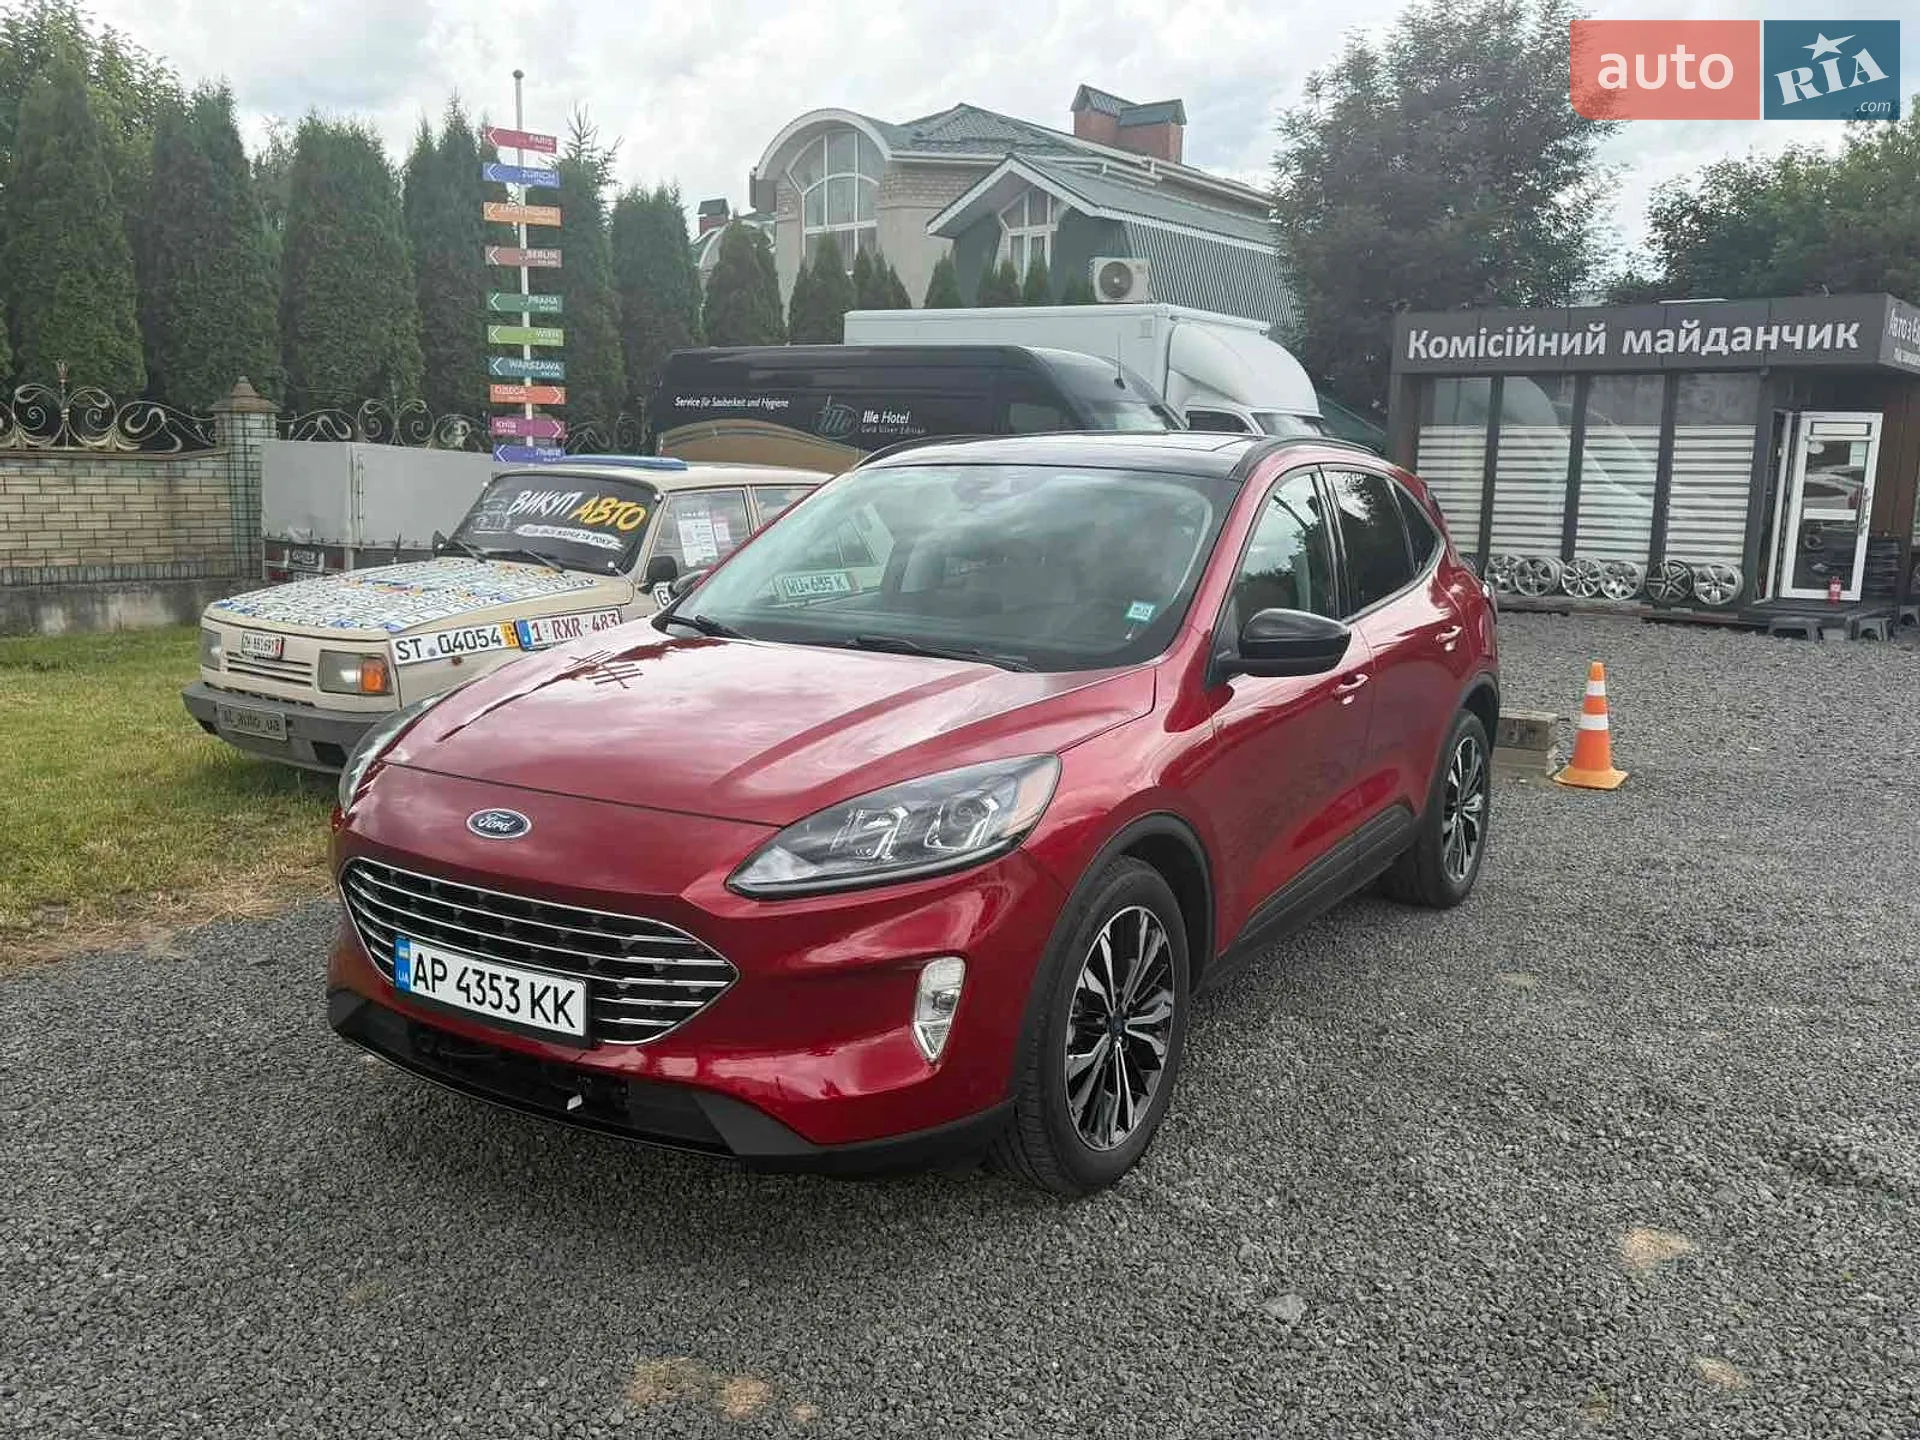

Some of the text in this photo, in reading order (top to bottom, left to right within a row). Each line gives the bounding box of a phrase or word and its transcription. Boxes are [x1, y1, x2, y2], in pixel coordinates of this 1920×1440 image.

[1408, 319, 1860, 359] Комісійний майданчик
[509, 360, 560, 370] WARSZAWA
[674, 396, 700, 407] Service
[881, 410, 910, 424] Hotel
[506, 489, 647, 532] ВИКУП АВТО
[395, 636, 422, 661] ST
[398, 971, 409, 986] UA
[413, 952, 576, 1029] AP 4353 KK
